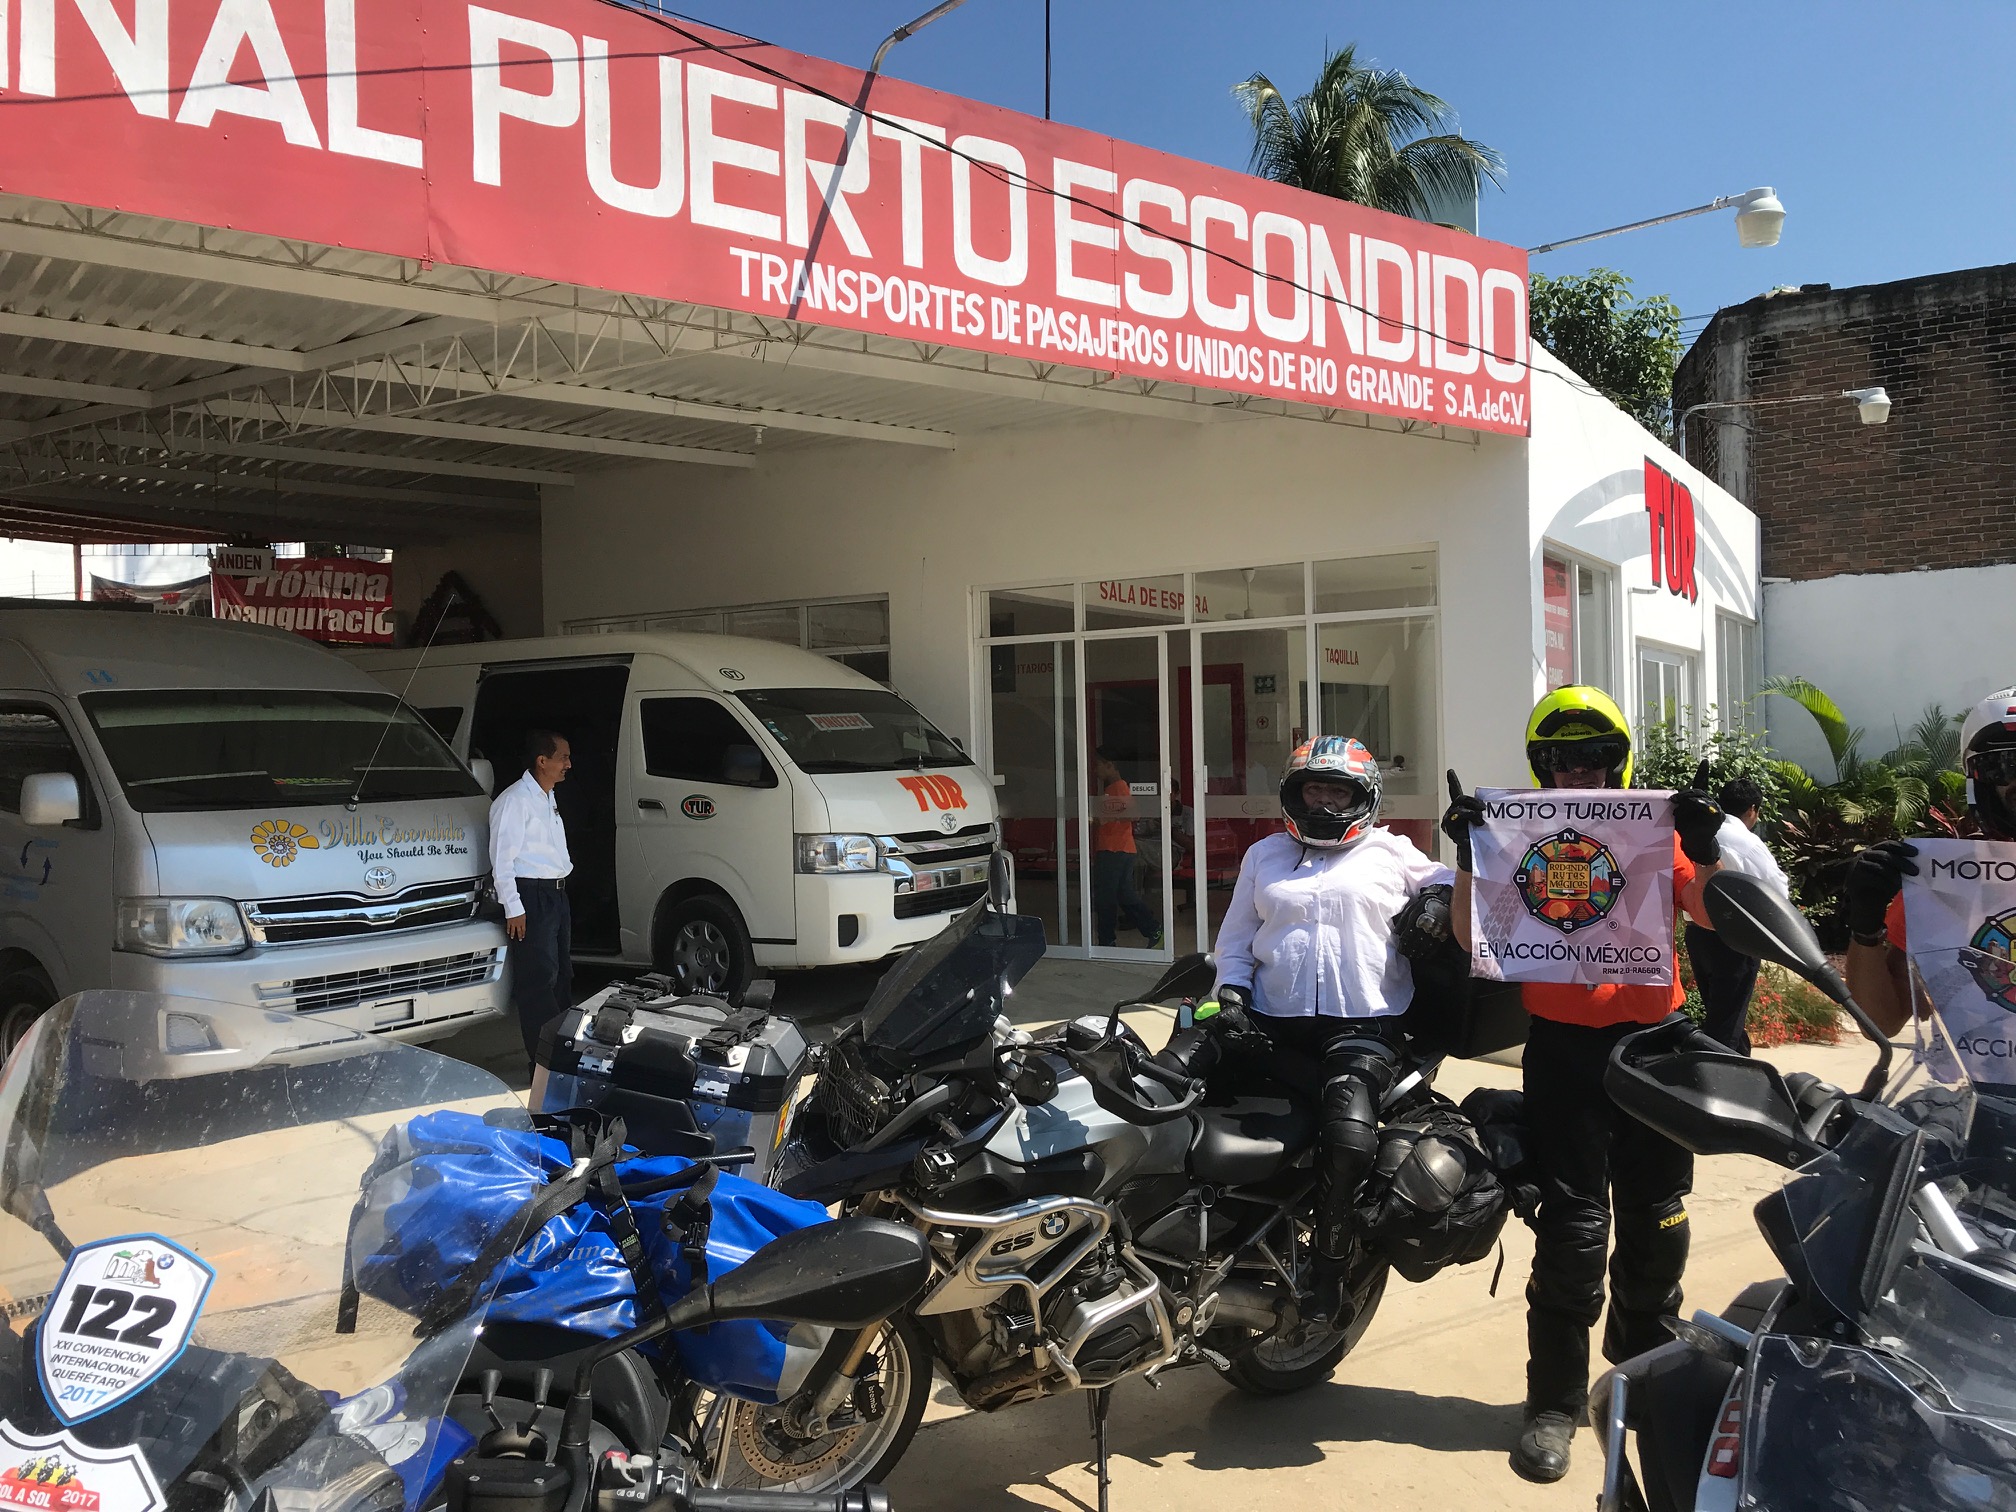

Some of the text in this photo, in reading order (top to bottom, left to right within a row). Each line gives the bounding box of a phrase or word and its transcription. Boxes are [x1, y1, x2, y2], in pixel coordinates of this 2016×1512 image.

[0, 0, 1527, 384] NAL PUERTO ESCONDIDO
[729, 246, 985, 337] TRANSPORTES
[991, 296, 1022, 344] DE
[1026, 303, 1169, 367] PASAJEROS
[1175, 331, 1265, 384] UNIDOS
[1269, 349, 1297, 390] DE
[1301, 353, 1338, 396] RIO
[1346, 364, 1434, 412] GRANDE
[1644, 455, 1699, 607] TUR
[216, 551, 277, 572] ANDEN 1
[1100, 581, 1209, 615] SALA DE ESPRA
[1325, 647, 1360, 666] TAQUILLA
[1016, 662, 1054, 675] ITARIOS
[1560, 730, 1593, 738] Schuberth
[896, 774, 968, 812] TUR
[688, 800, 712, 815] TUR
[1486, 802, 1653, 820] MOTO TURISTA
[318, 813, 466, 850] Villa Escondida
[1563, 832, 1575, 841] N
[356, 843, 469, 865] You Should Be Here
[1516, 874, 1527, 883] O
[1931, 858, 2016, 881] MOTO
[1612, 878, 1622, 886] E
[1563, 920, 1573, 929] S
[1479, 940, 1661, 964] EN ACCIÓN MÉXICO
[1602, 967, 1619, 975] RRM
[1956, 1036, 2016, 1058] ACCI
[990, 1231, 1037, 1256] GS
[59, 1284, 177, 1349] 122
[53, 1339, 150, 1365] XXI CONVENCIÓN
[50, 1353, 141, 1379] INTERNACIONAL
[51, 1368, 126, 1390] QUERÉTARO
[58, 1385, 108, 1405] 2017
[868, 1385, 878, 1414] brembo
[0, 1483, 98, 1507] OL A SOL 2017
